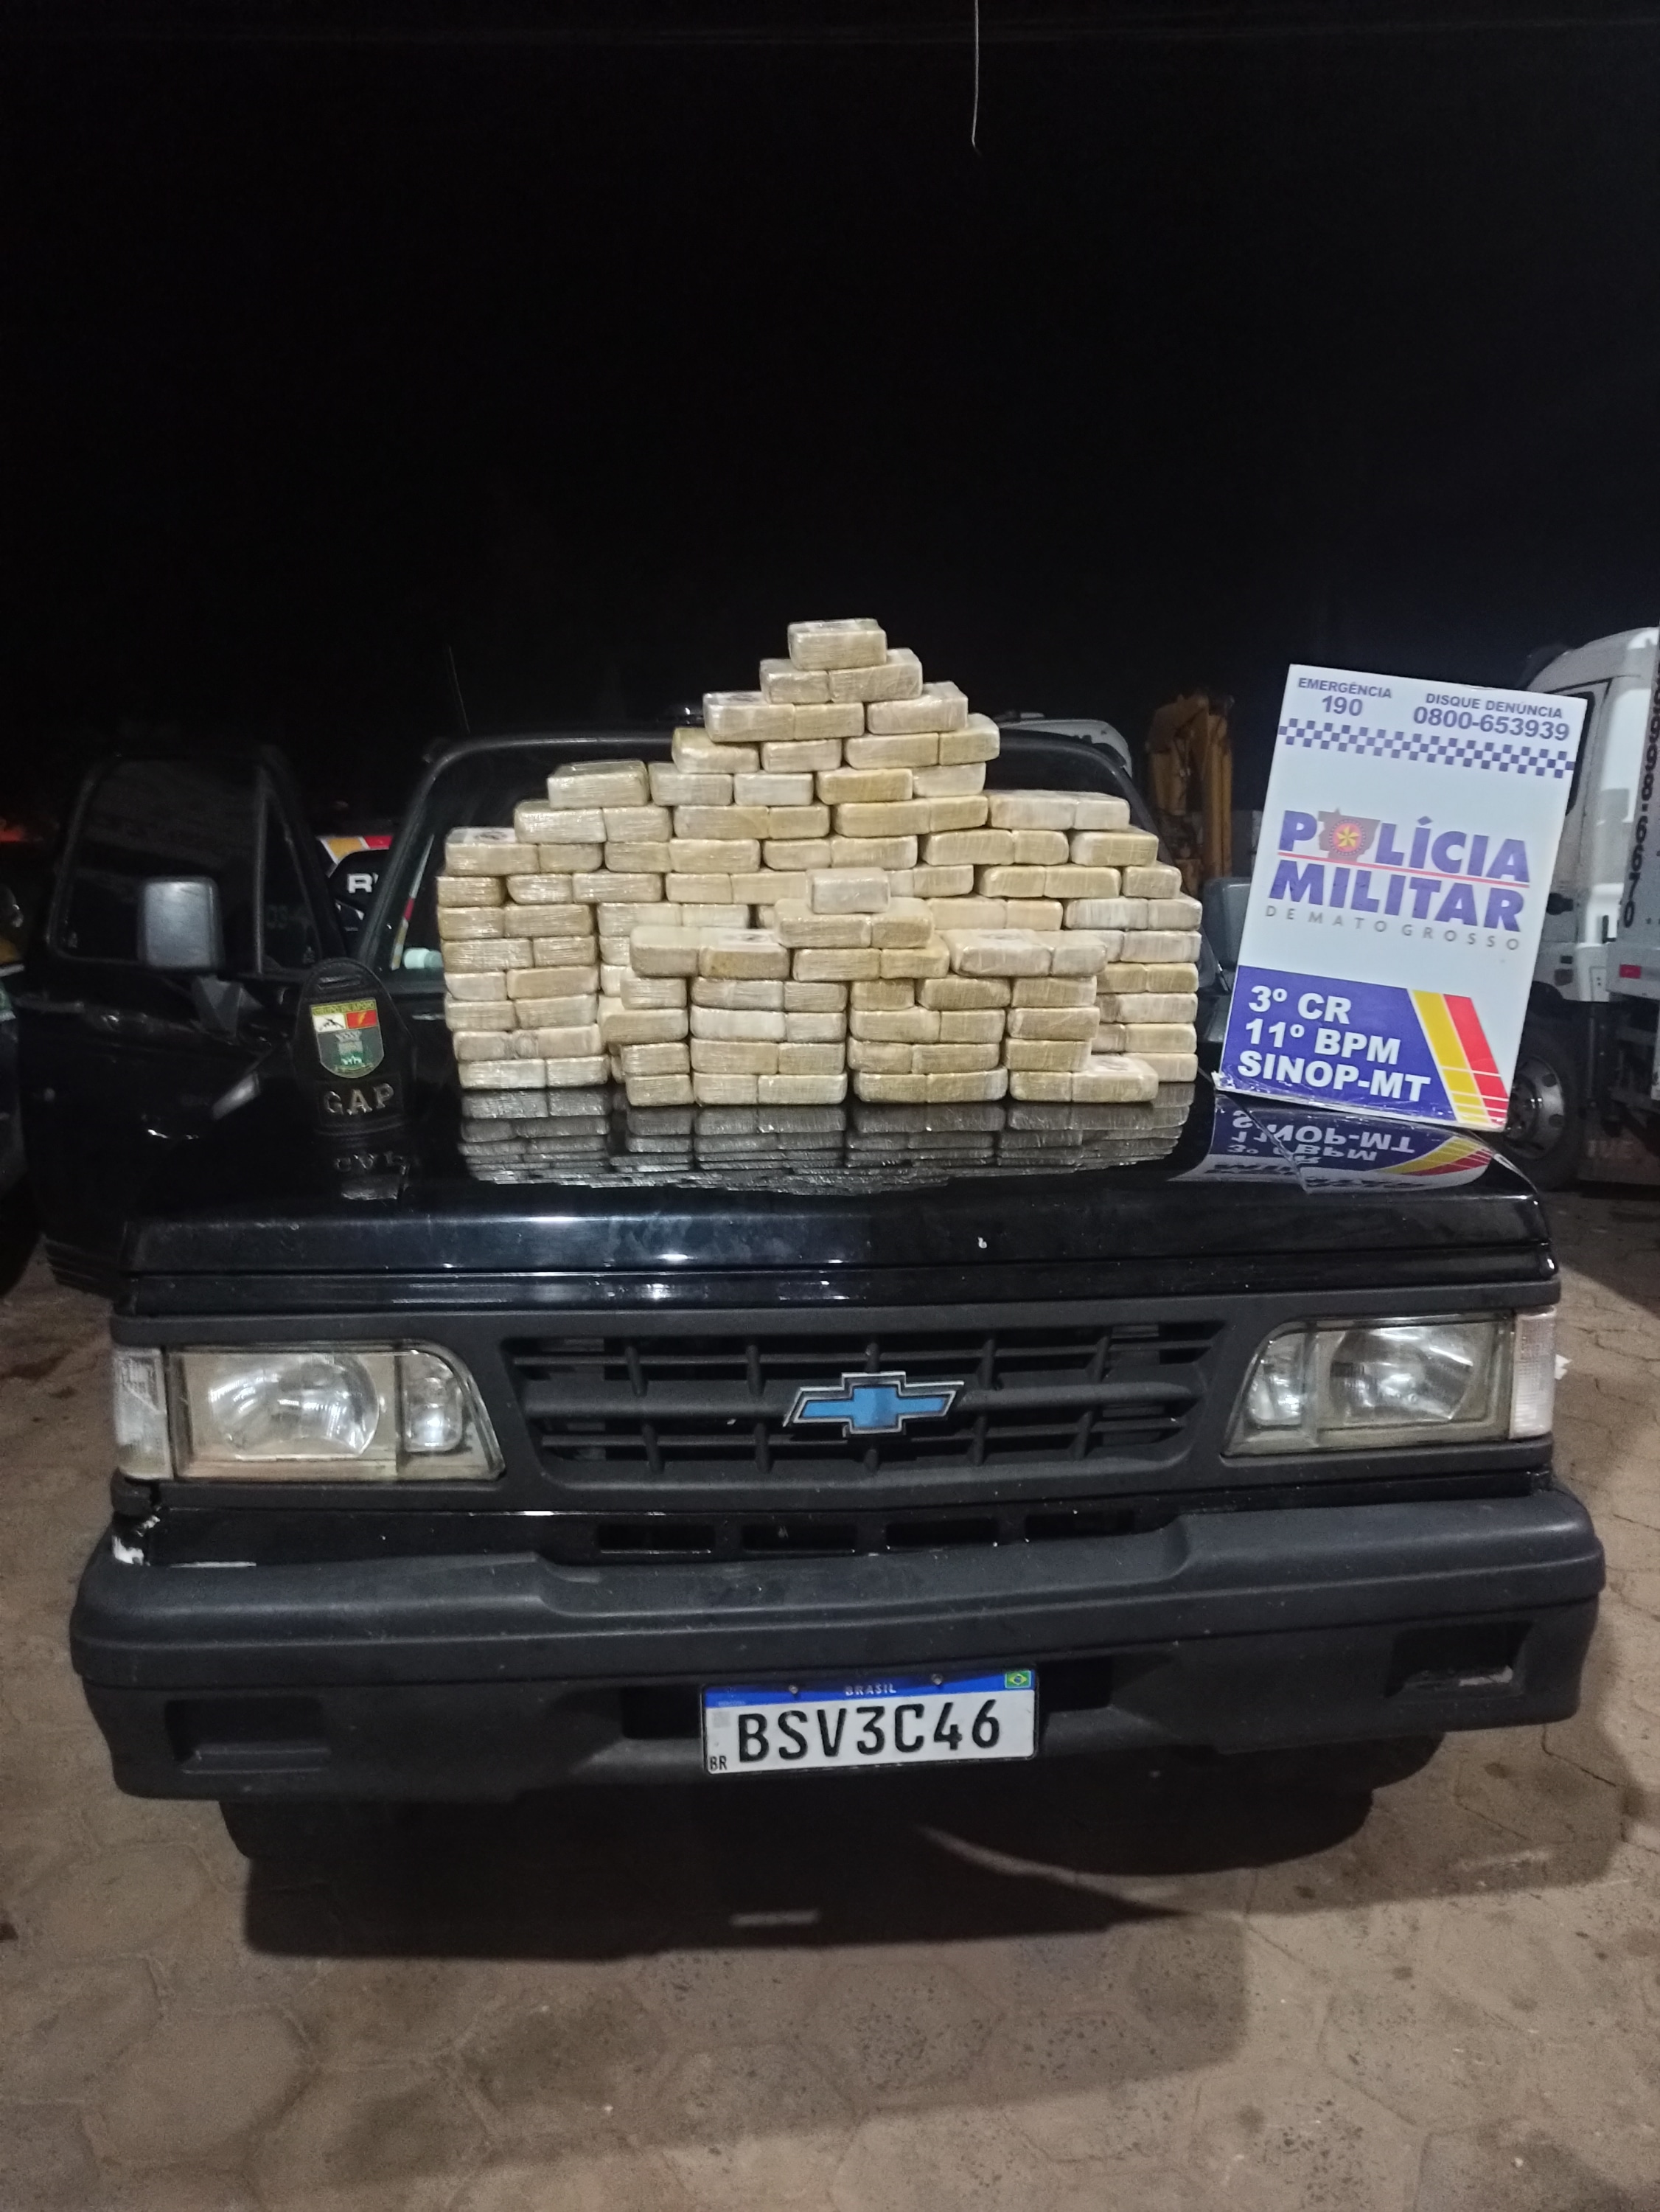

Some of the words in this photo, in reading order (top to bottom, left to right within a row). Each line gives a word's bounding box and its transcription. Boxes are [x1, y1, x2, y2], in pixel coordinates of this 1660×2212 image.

[1298, 677, 1392, 699] EMERGÊNCIA
[1321, 695, 1364, 717] 190
[1426, 693, 1481, 710] DISQUE
[1485, 700, 1563, 720] DENÚNCIA
[1413, 706, 1571, 742] 0800-653939
[1269, 860, 1525, 933] MILITAR
[1266, 905, 1295, 921] DE
[1308, 911, 1387, 933] MATO
[1401, 925, 1520, 951] GROSSO
[1297, 992, 1352, 1025] CR
[1314, 1028, 1401, 1065] BPM
[1237, 1051, 1431, 1102] SINOP-MT
[324, 1082, 394, 1116] GAP
[845, 1683, 897, 1696] BRASIL
[738, 1699, 1000, 1763] BSV3C46
[709, 1755, 728, 1771] BR
